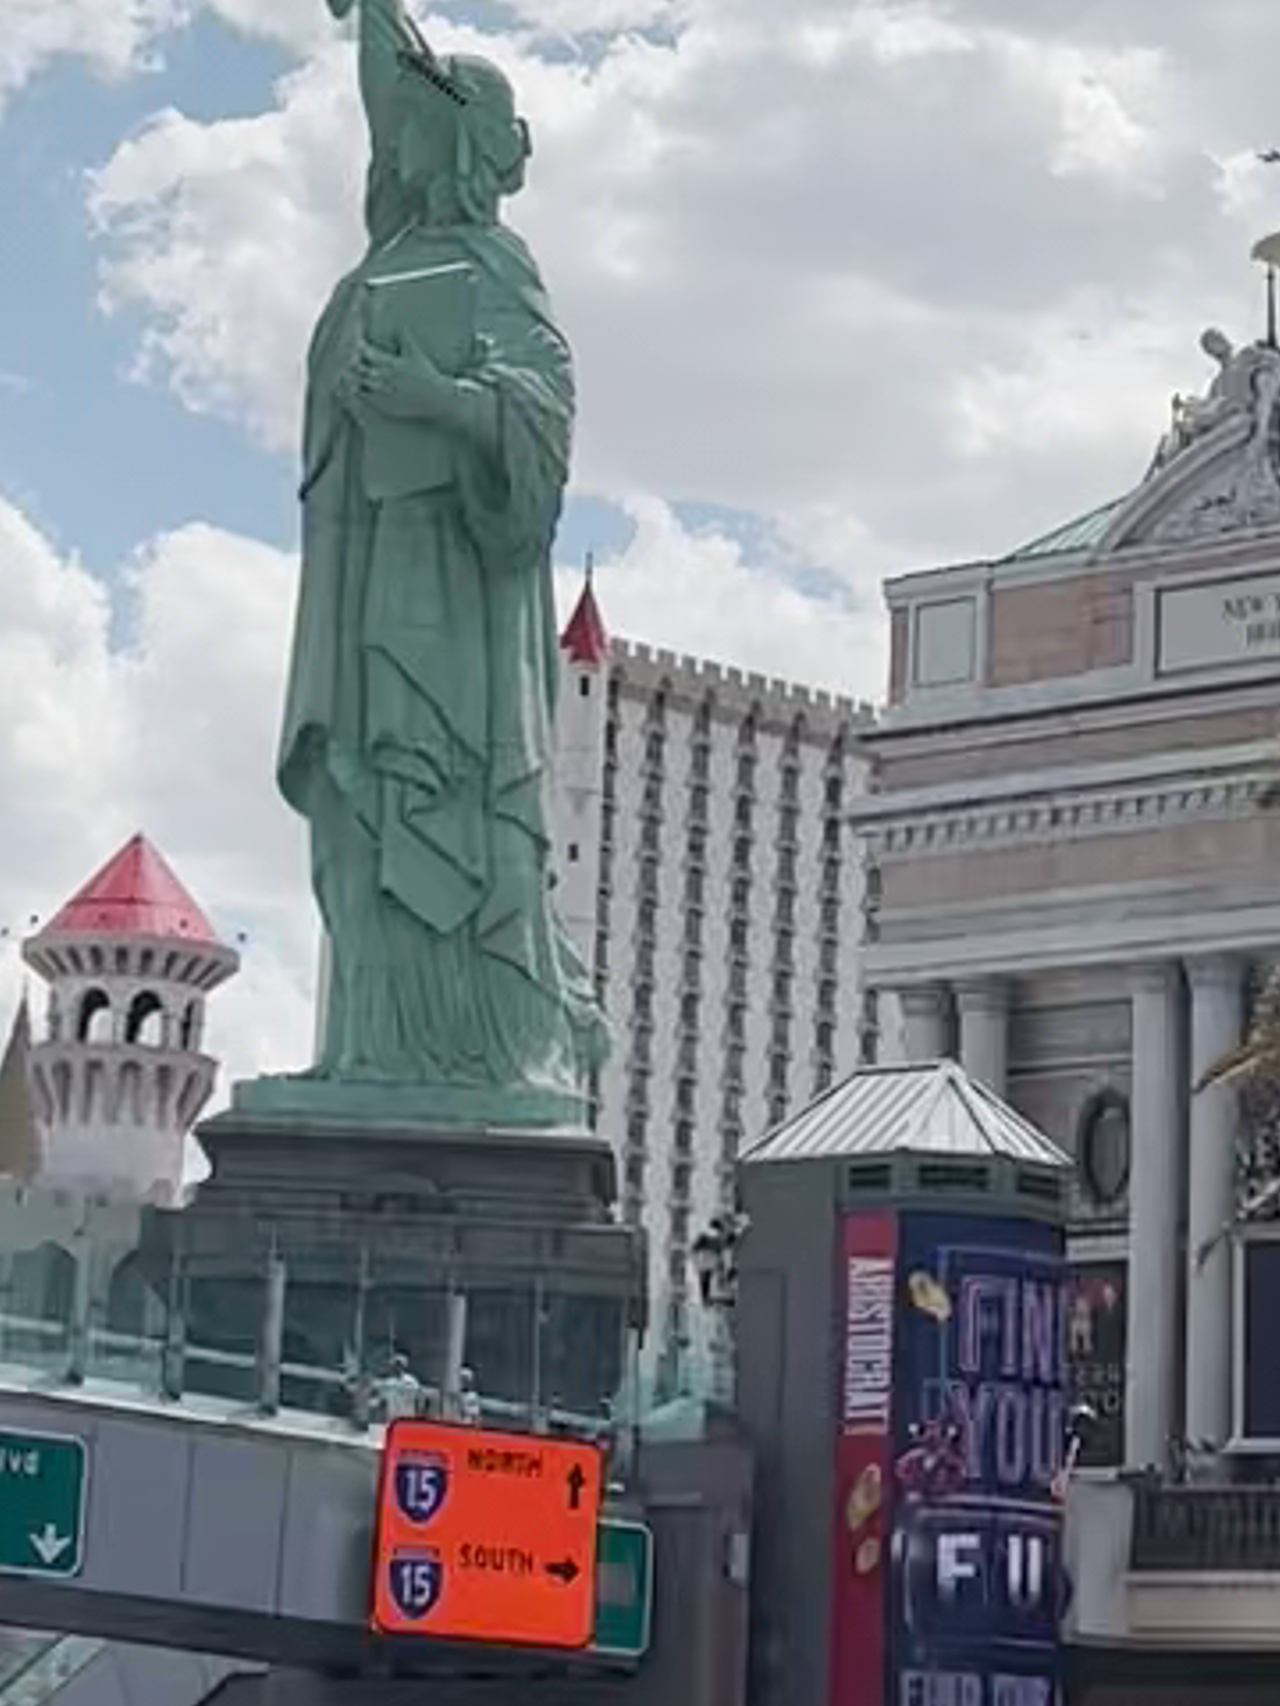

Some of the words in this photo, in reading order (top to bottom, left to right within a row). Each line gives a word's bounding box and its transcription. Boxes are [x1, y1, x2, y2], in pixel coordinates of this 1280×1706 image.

[1222, 593, 1267, 622] NEW
[845, 1256, 895, 1436] ARISTOCRAT
[406, 1468, 437, 1508] 15
[467, 1448, 543, 1478] NORTH
[400, 1563, 430, 1606] 15
[459, 1543, 533, 1574] SOUTH
